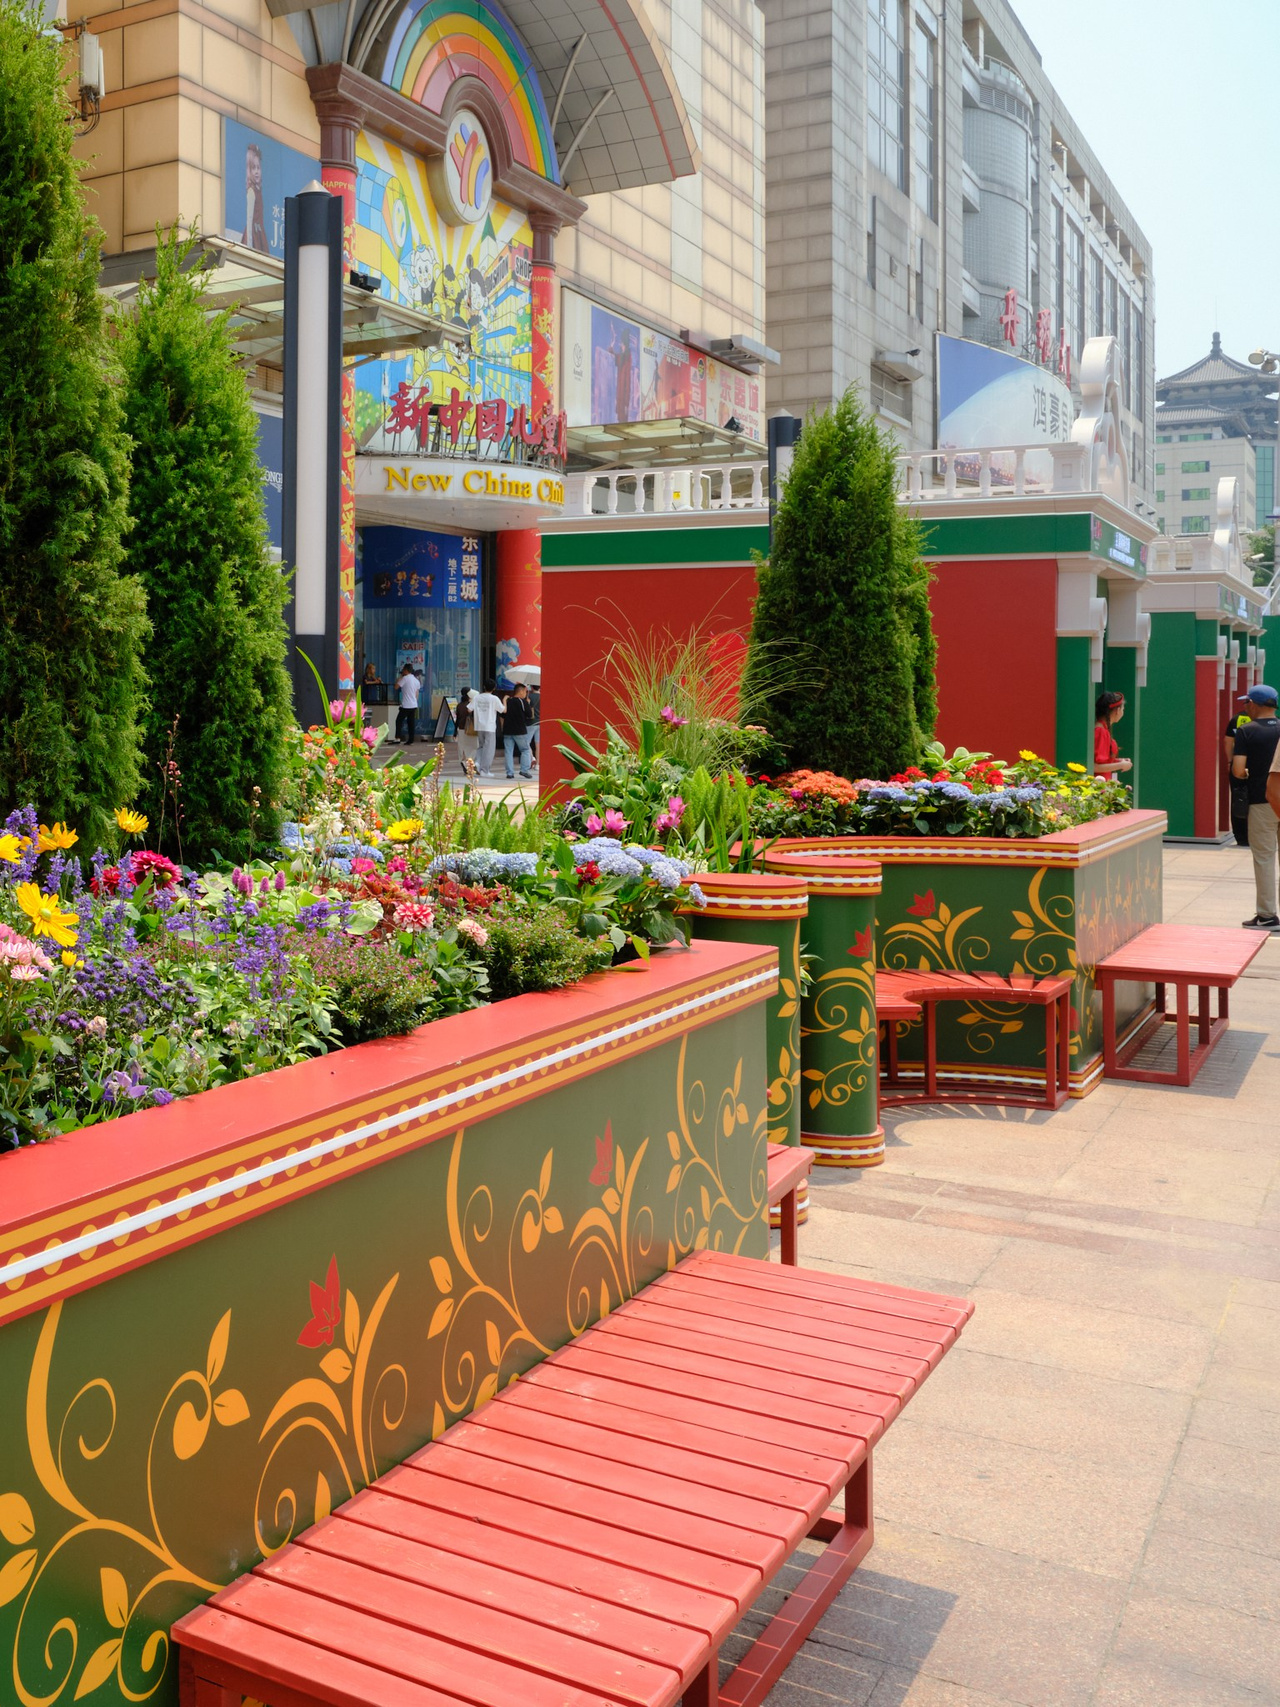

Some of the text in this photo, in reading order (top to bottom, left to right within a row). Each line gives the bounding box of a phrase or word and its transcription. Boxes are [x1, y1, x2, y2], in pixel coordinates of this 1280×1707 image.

[322, 180, 347, 190] HAPPY
[515, 255, 533, 281] SHOP
[384, 466, 453, 492] New
[463, 470, 533, 498] China
[460, 537, 479, 602] 乐器城
